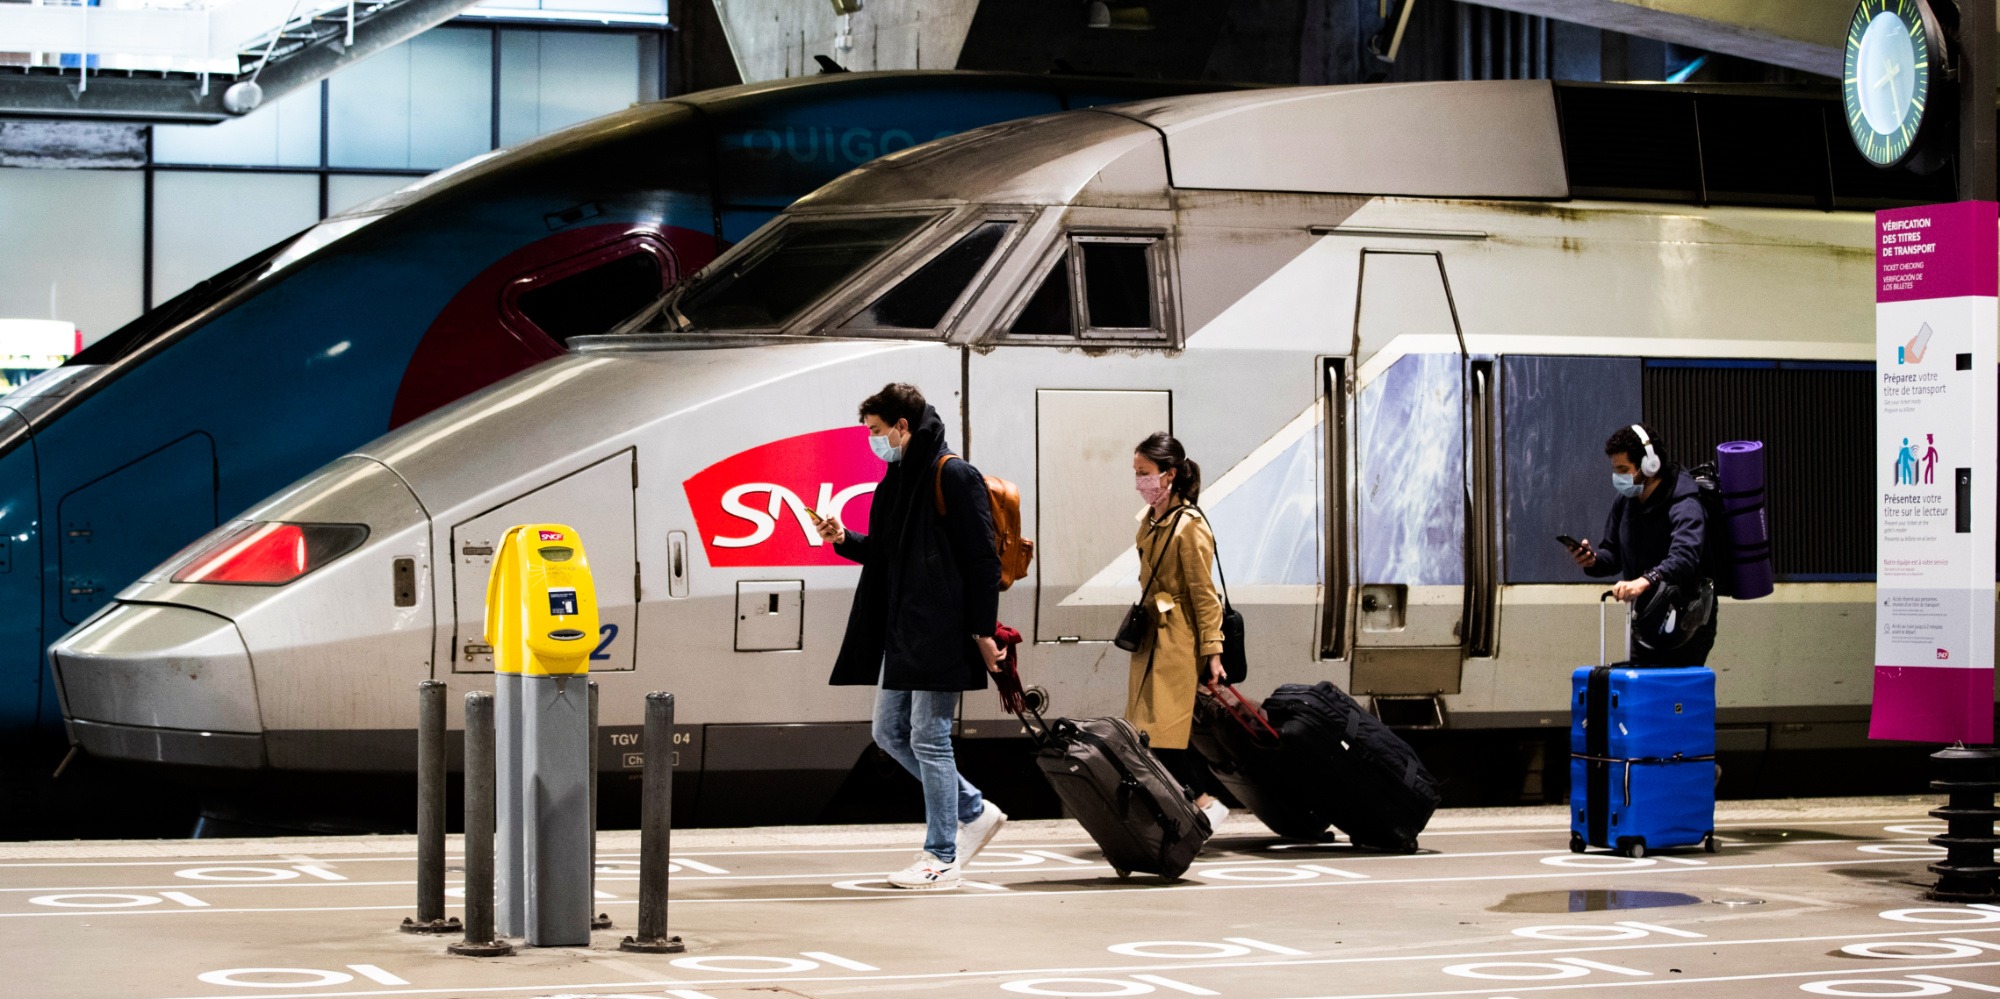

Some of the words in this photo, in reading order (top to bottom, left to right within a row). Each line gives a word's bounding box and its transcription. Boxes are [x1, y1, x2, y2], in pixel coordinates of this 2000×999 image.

[1882, 218, 1931, 231] VÉRIFICATION
[1883, 234, 1896, 244] DES
[1898, 232, 1921, 242] TITRES
[1883, 247, 1892, 256] DE
[1894, 243, 1936, 255] TRANSPORT
[1900, 262, 1924, 270] CHECKING
[1884, 373, 1917, 385] Préparez
[1918, 372, 1938, 381] votre
[1884, 386, 1899, 396] titre
[1902, 385, 1910, 395] de
[1912, 385, 1946, 396] transport
[1884, 494, 1920, 504] Présentez
[1922, 495, 1941, 503] votre
[712, 482, 879, 548] SNC
[1884, 507, 1899, 517] titre
[1914, 506, 1920, 516] le
[1923, 506, 1948, 516] lecteur
[610, 734, 638, 746] TGV
